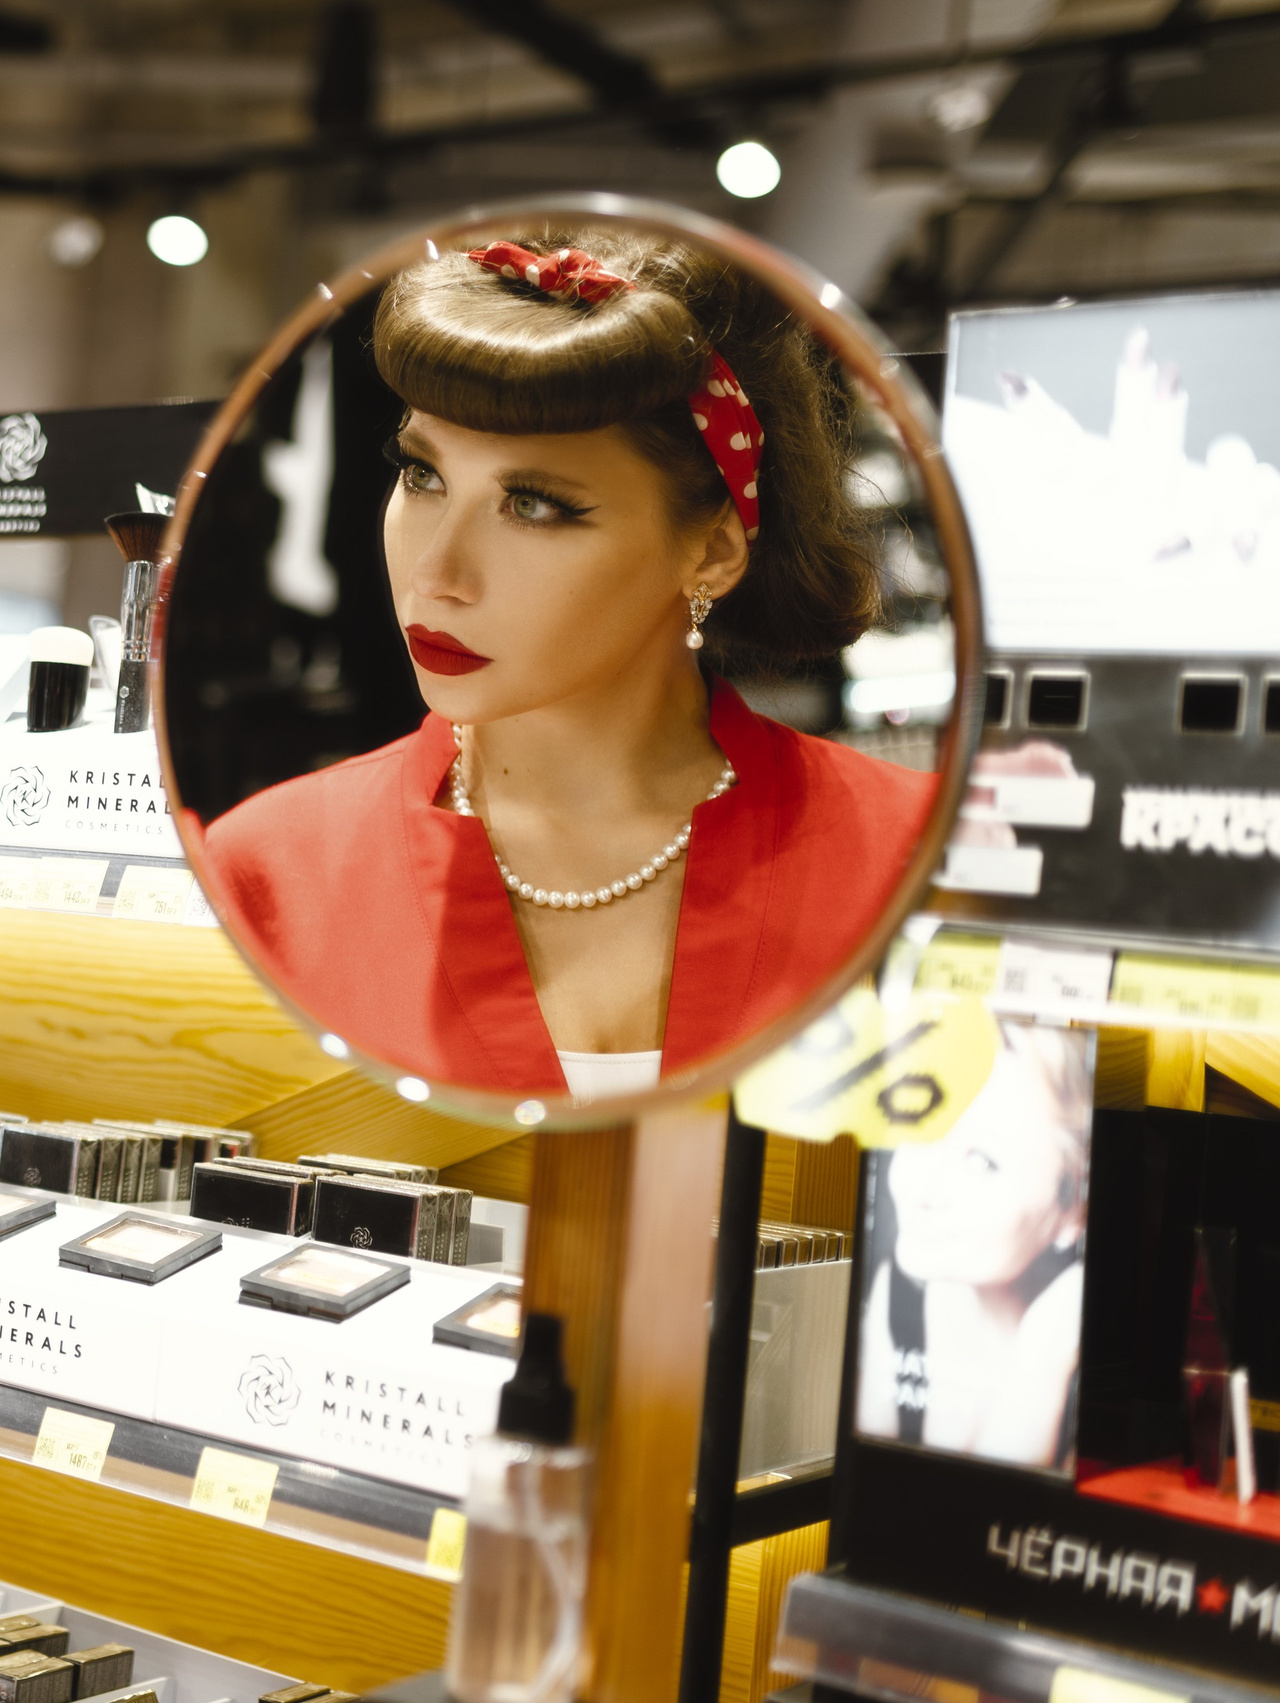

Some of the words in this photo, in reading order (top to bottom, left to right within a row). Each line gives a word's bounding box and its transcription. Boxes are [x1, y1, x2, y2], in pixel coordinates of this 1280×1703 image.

[69, 770, 167, 789] KRISTAL
[67, 795, 174, 816] MINERAL
[65, 820, 163, 836] COSMETICS
[325, 1370, 464, 1417] KRISTALL
[322, 1400, 475, 1450] MINERALS
[986, 1521, 1198, 1618] ЧЁРНАЯ
